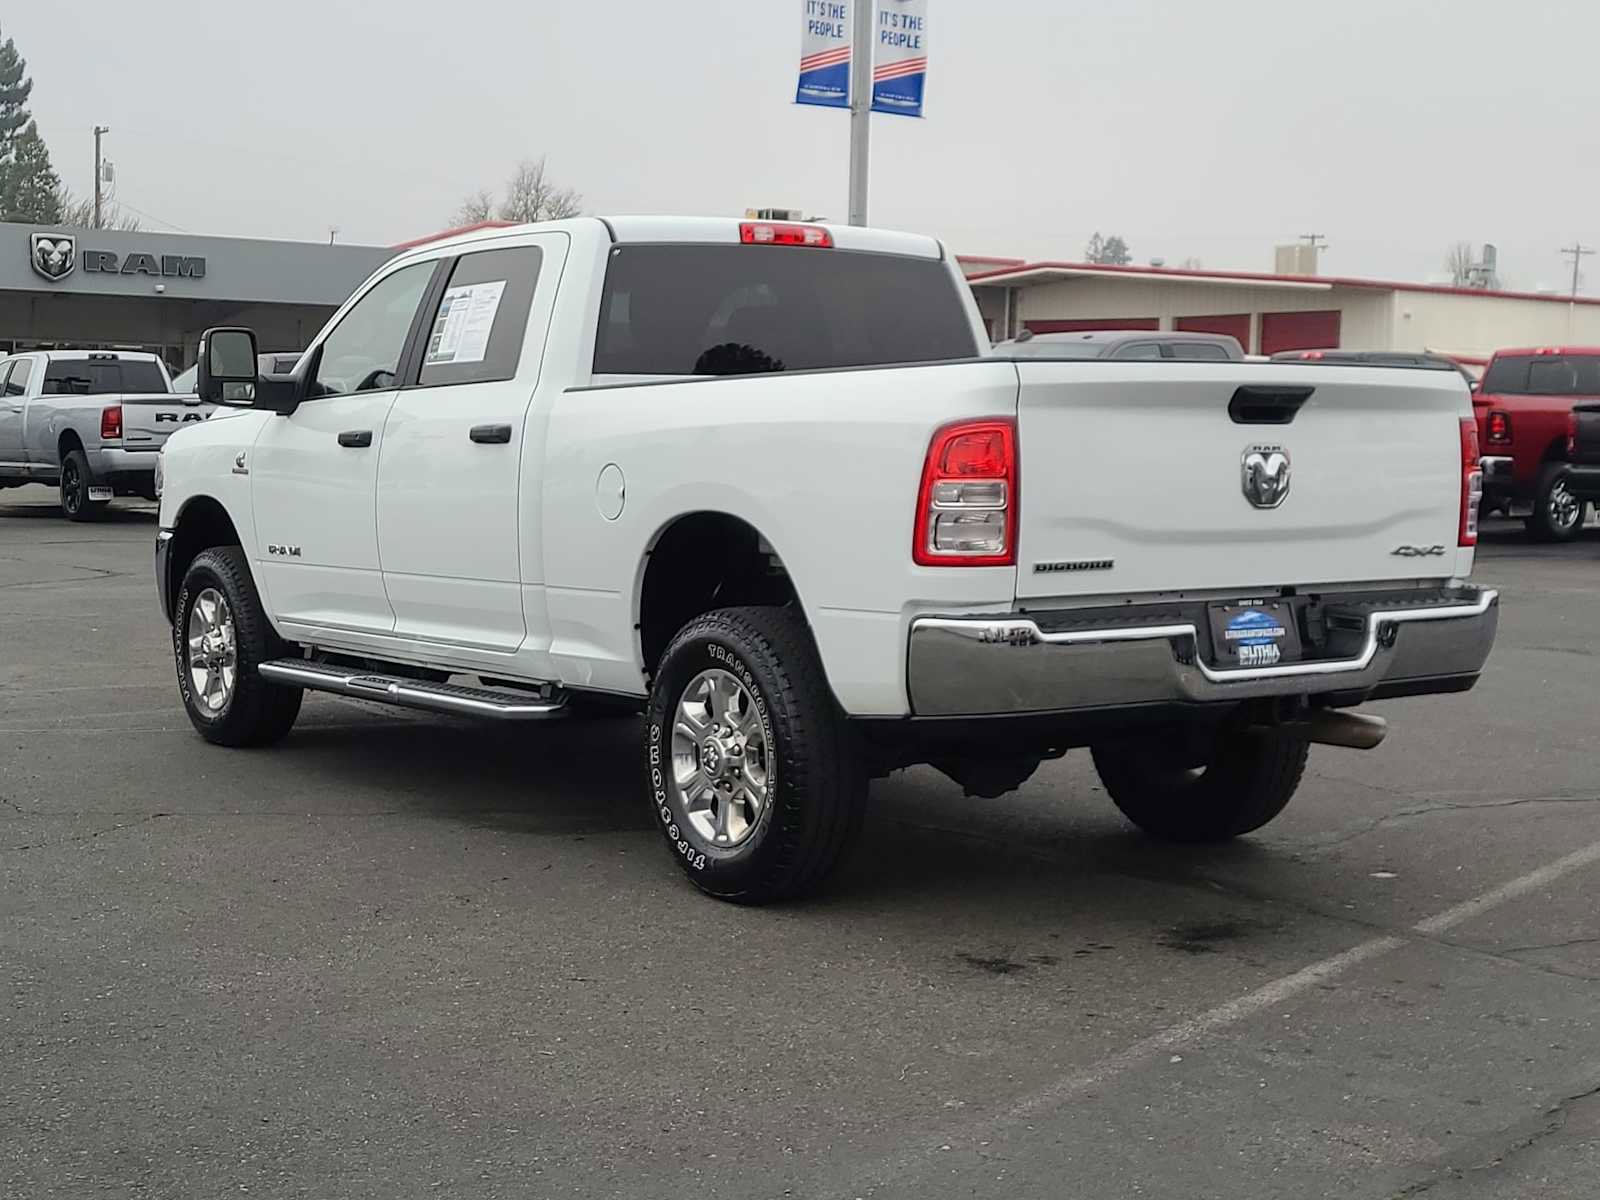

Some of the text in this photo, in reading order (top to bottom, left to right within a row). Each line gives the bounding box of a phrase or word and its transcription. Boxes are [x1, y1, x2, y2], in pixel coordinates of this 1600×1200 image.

[807, 0, 845, 19] IT'S THE
[808, 19, 843, 38] PEOPLE
[880, 11, 923, 30] IT'S THE
[881, 30, 920, 49] PEOPLE
[83, 250, 206, 278] RAM
